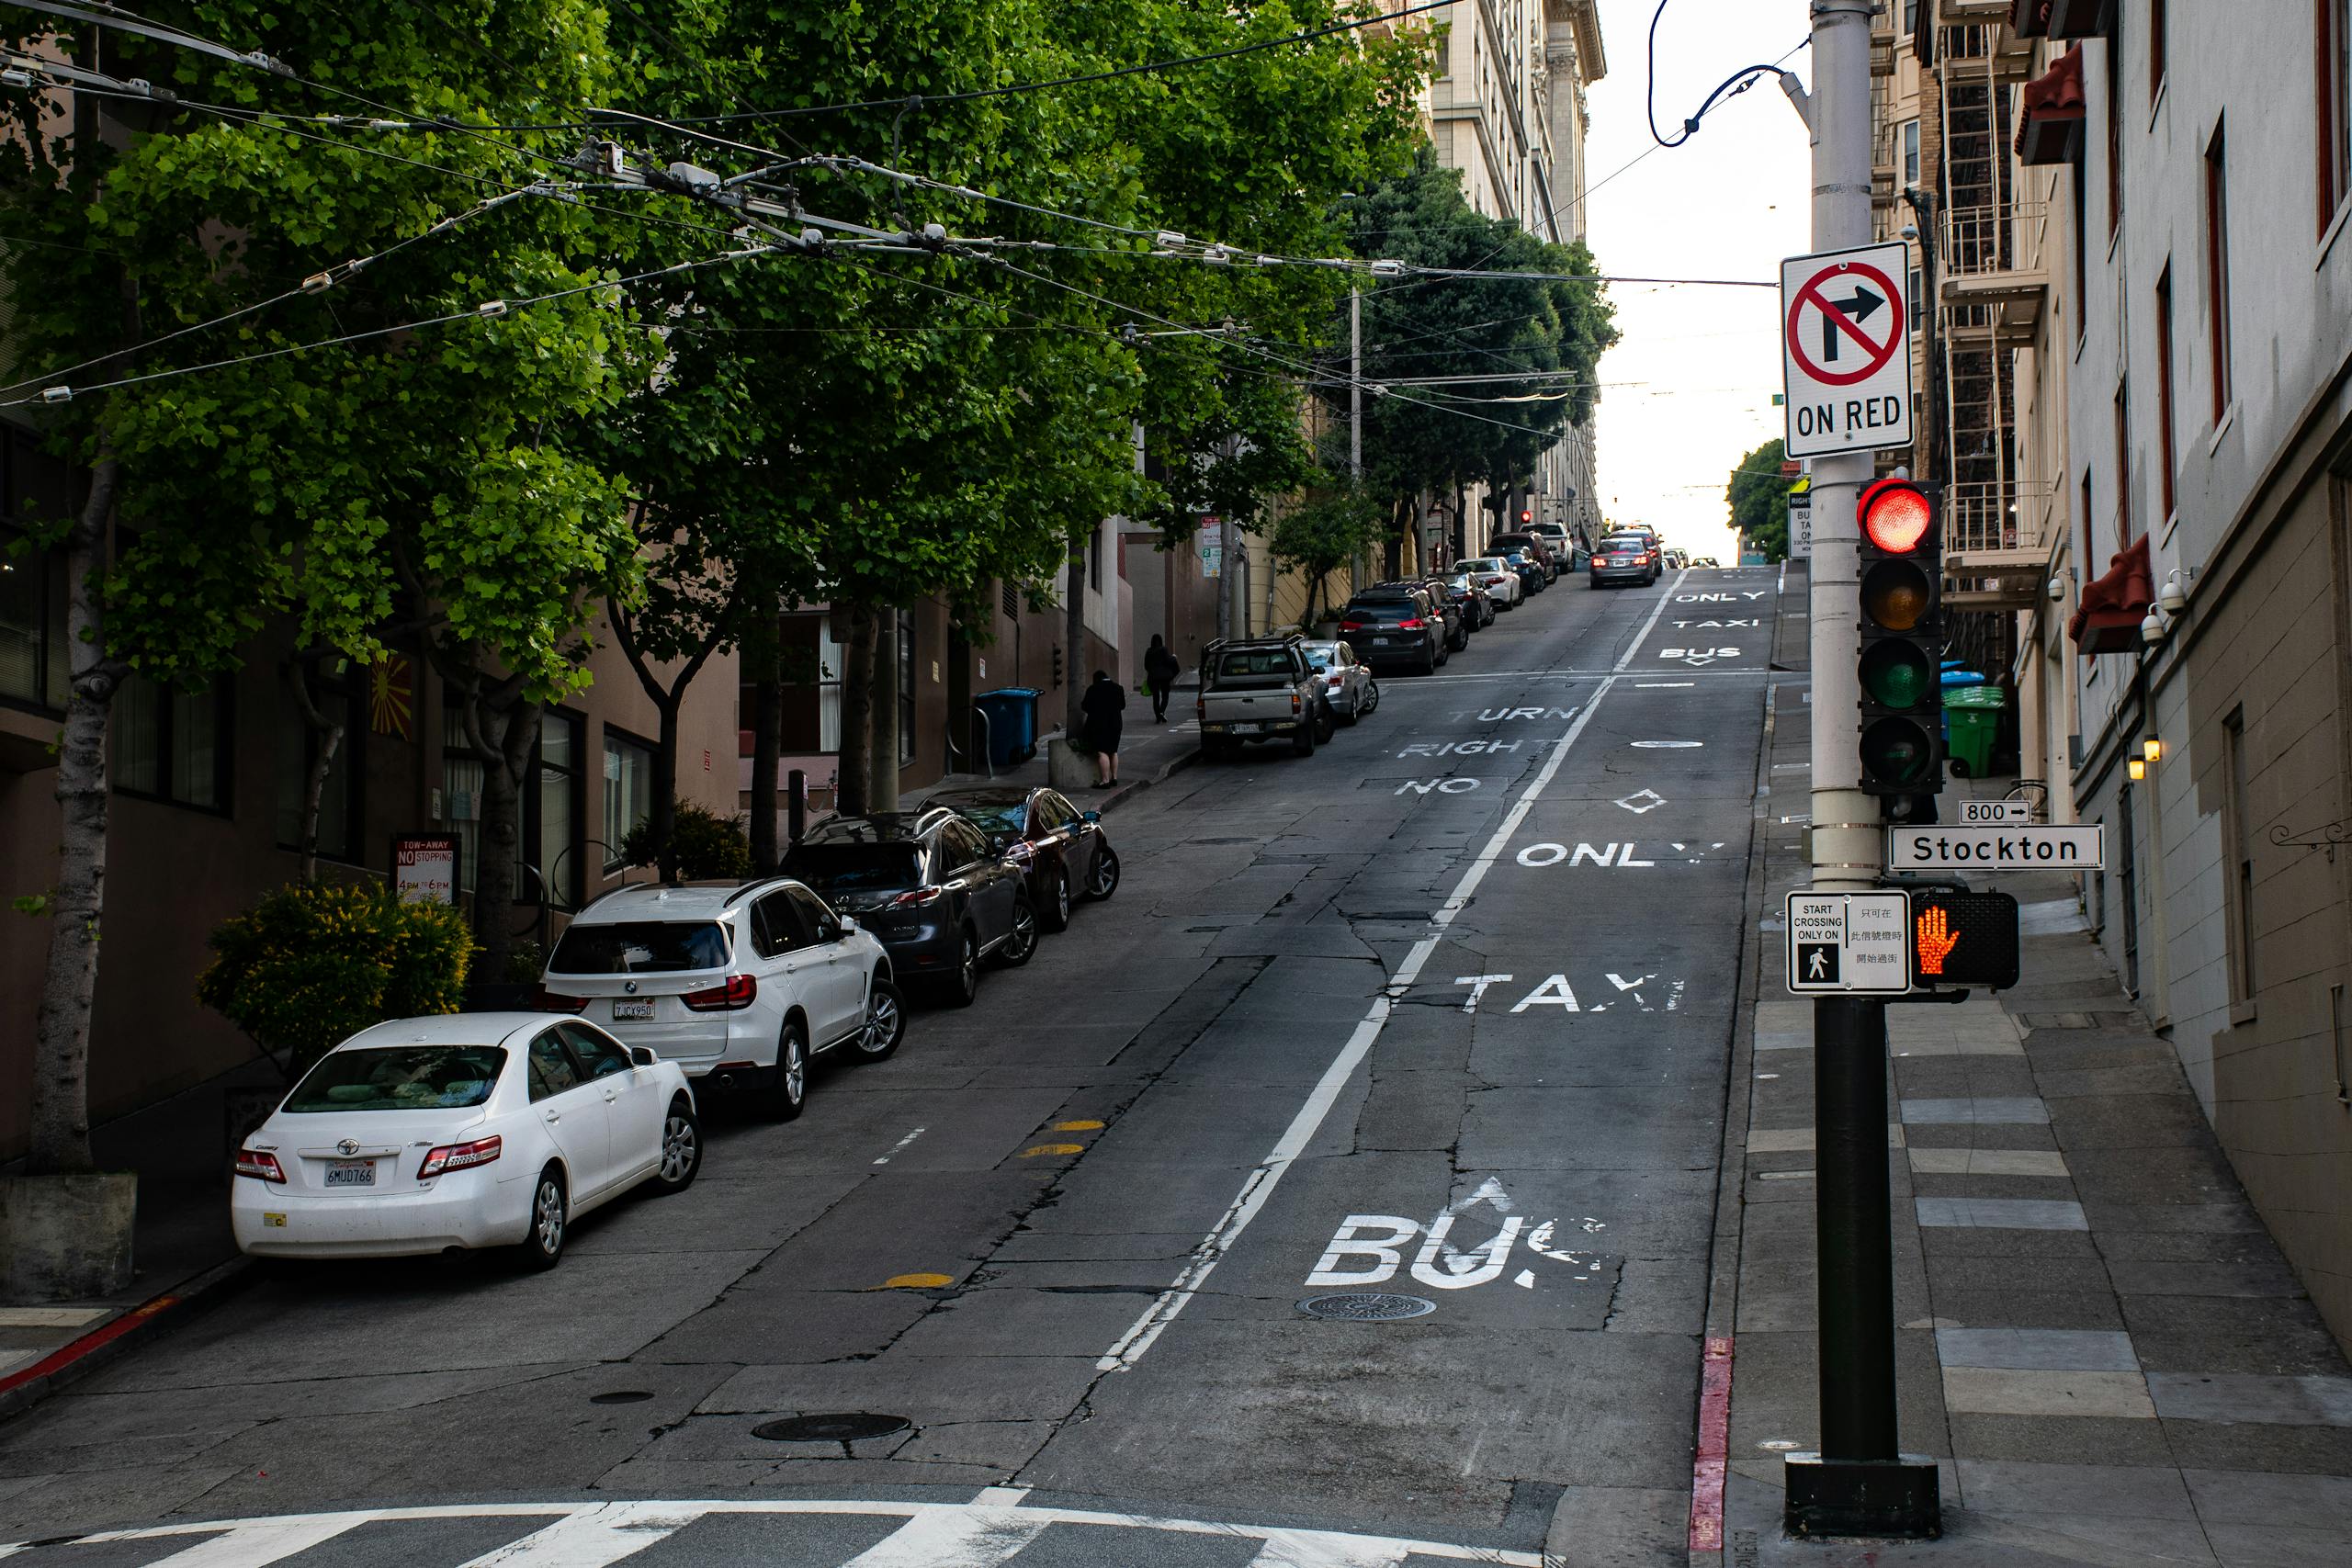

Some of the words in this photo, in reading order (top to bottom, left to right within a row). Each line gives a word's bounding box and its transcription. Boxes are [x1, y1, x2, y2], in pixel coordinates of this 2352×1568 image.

[1797, 404, 1834, 436] ON
[1846, 396, 1901, 431] RED
[1801, 521, 1811, 530] TA
[1801, 531, 1811, 540] ON
[1675, 591, 1765, 603] ONLY
[1672, 619, 1759, 628] TAXI
[1659, 647, 1741, 659] BUS
[1449, 705, 1579, 722] TURN
[1396, 739, 1563, 759] RIGHT
[1394, 777, 1482, 795] NO
[1967, 805, 2004, 820] 800
[404, 840, 449, 850] TOW-AWAY
[1913, 837, 2077, 861] Stockton
[398, 851, 414, 863] NO
[416, 852, 452, 862] STOPPING
[1803, 905, 1833, 914] START
[1860, 908, 1892, 919] 只可在
[1794, 918, 1842, 927] CROSSING
[1798, 931, 1823, 940] ONLY
[1825, 931, 1838, 940] ON
[1856, 953, 1897, 964] 開始過街
[327, 1169, 372, 1184] 6MUD766
